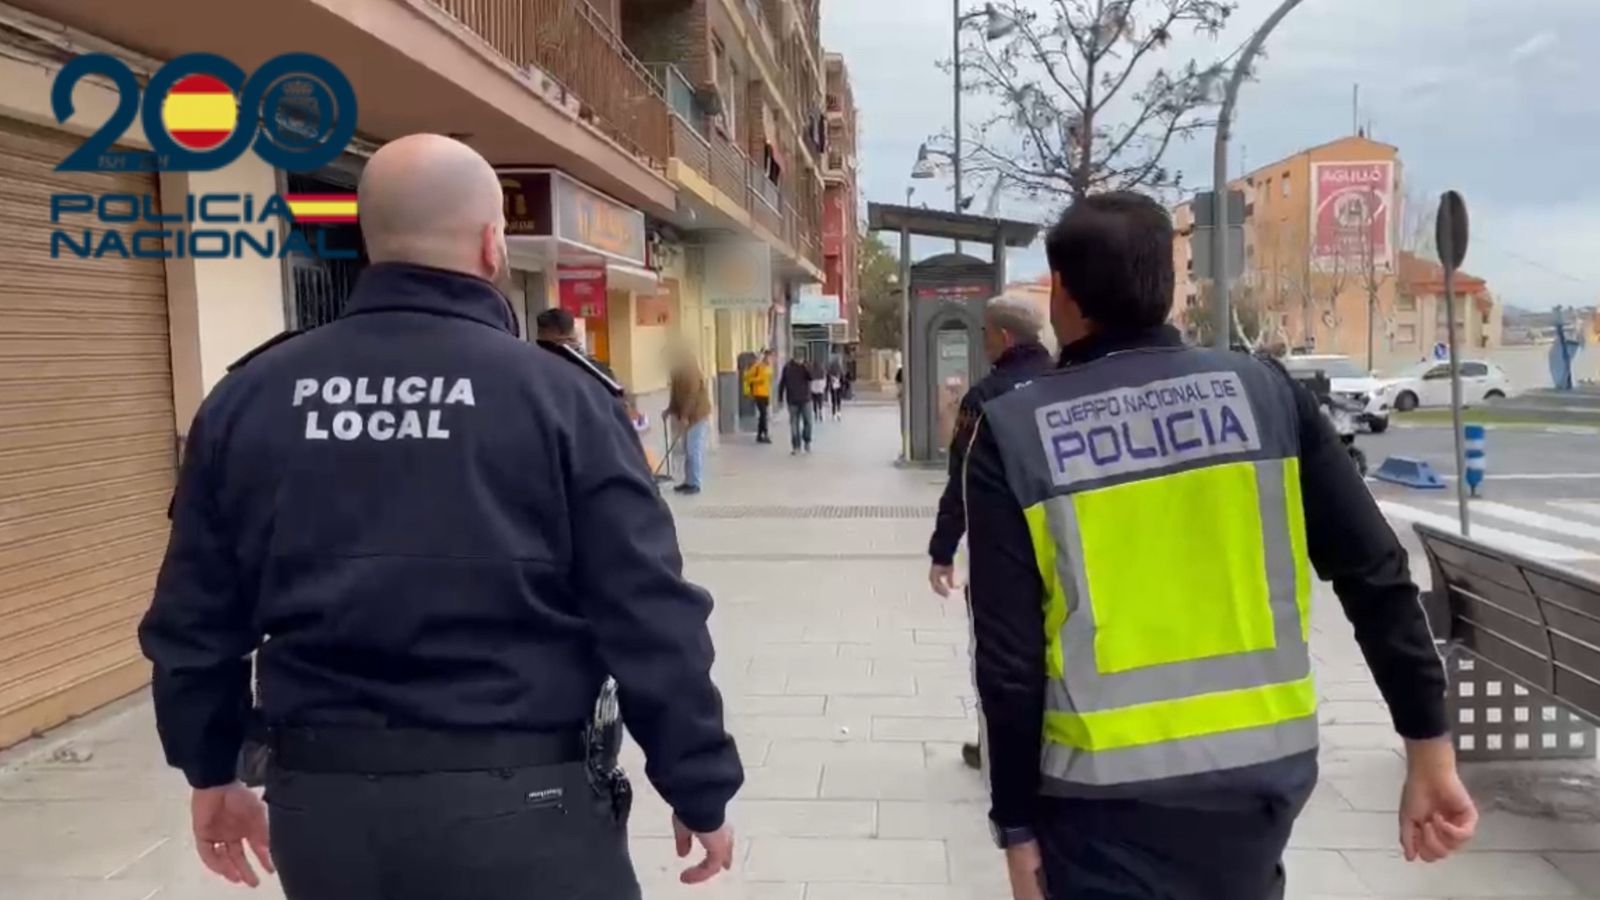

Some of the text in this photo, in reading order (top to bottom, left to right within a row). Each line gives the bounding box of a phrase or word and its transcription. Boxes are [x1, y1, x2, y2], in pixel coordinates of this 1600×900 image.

[293, 376, 475, 407] POLICIA
[1046, 379, 1238, 428] CUERPO NACIONAL DE
[305, 409, 450, 440] LOCAL
[1051, 405, 1248, 473] POLICIA
